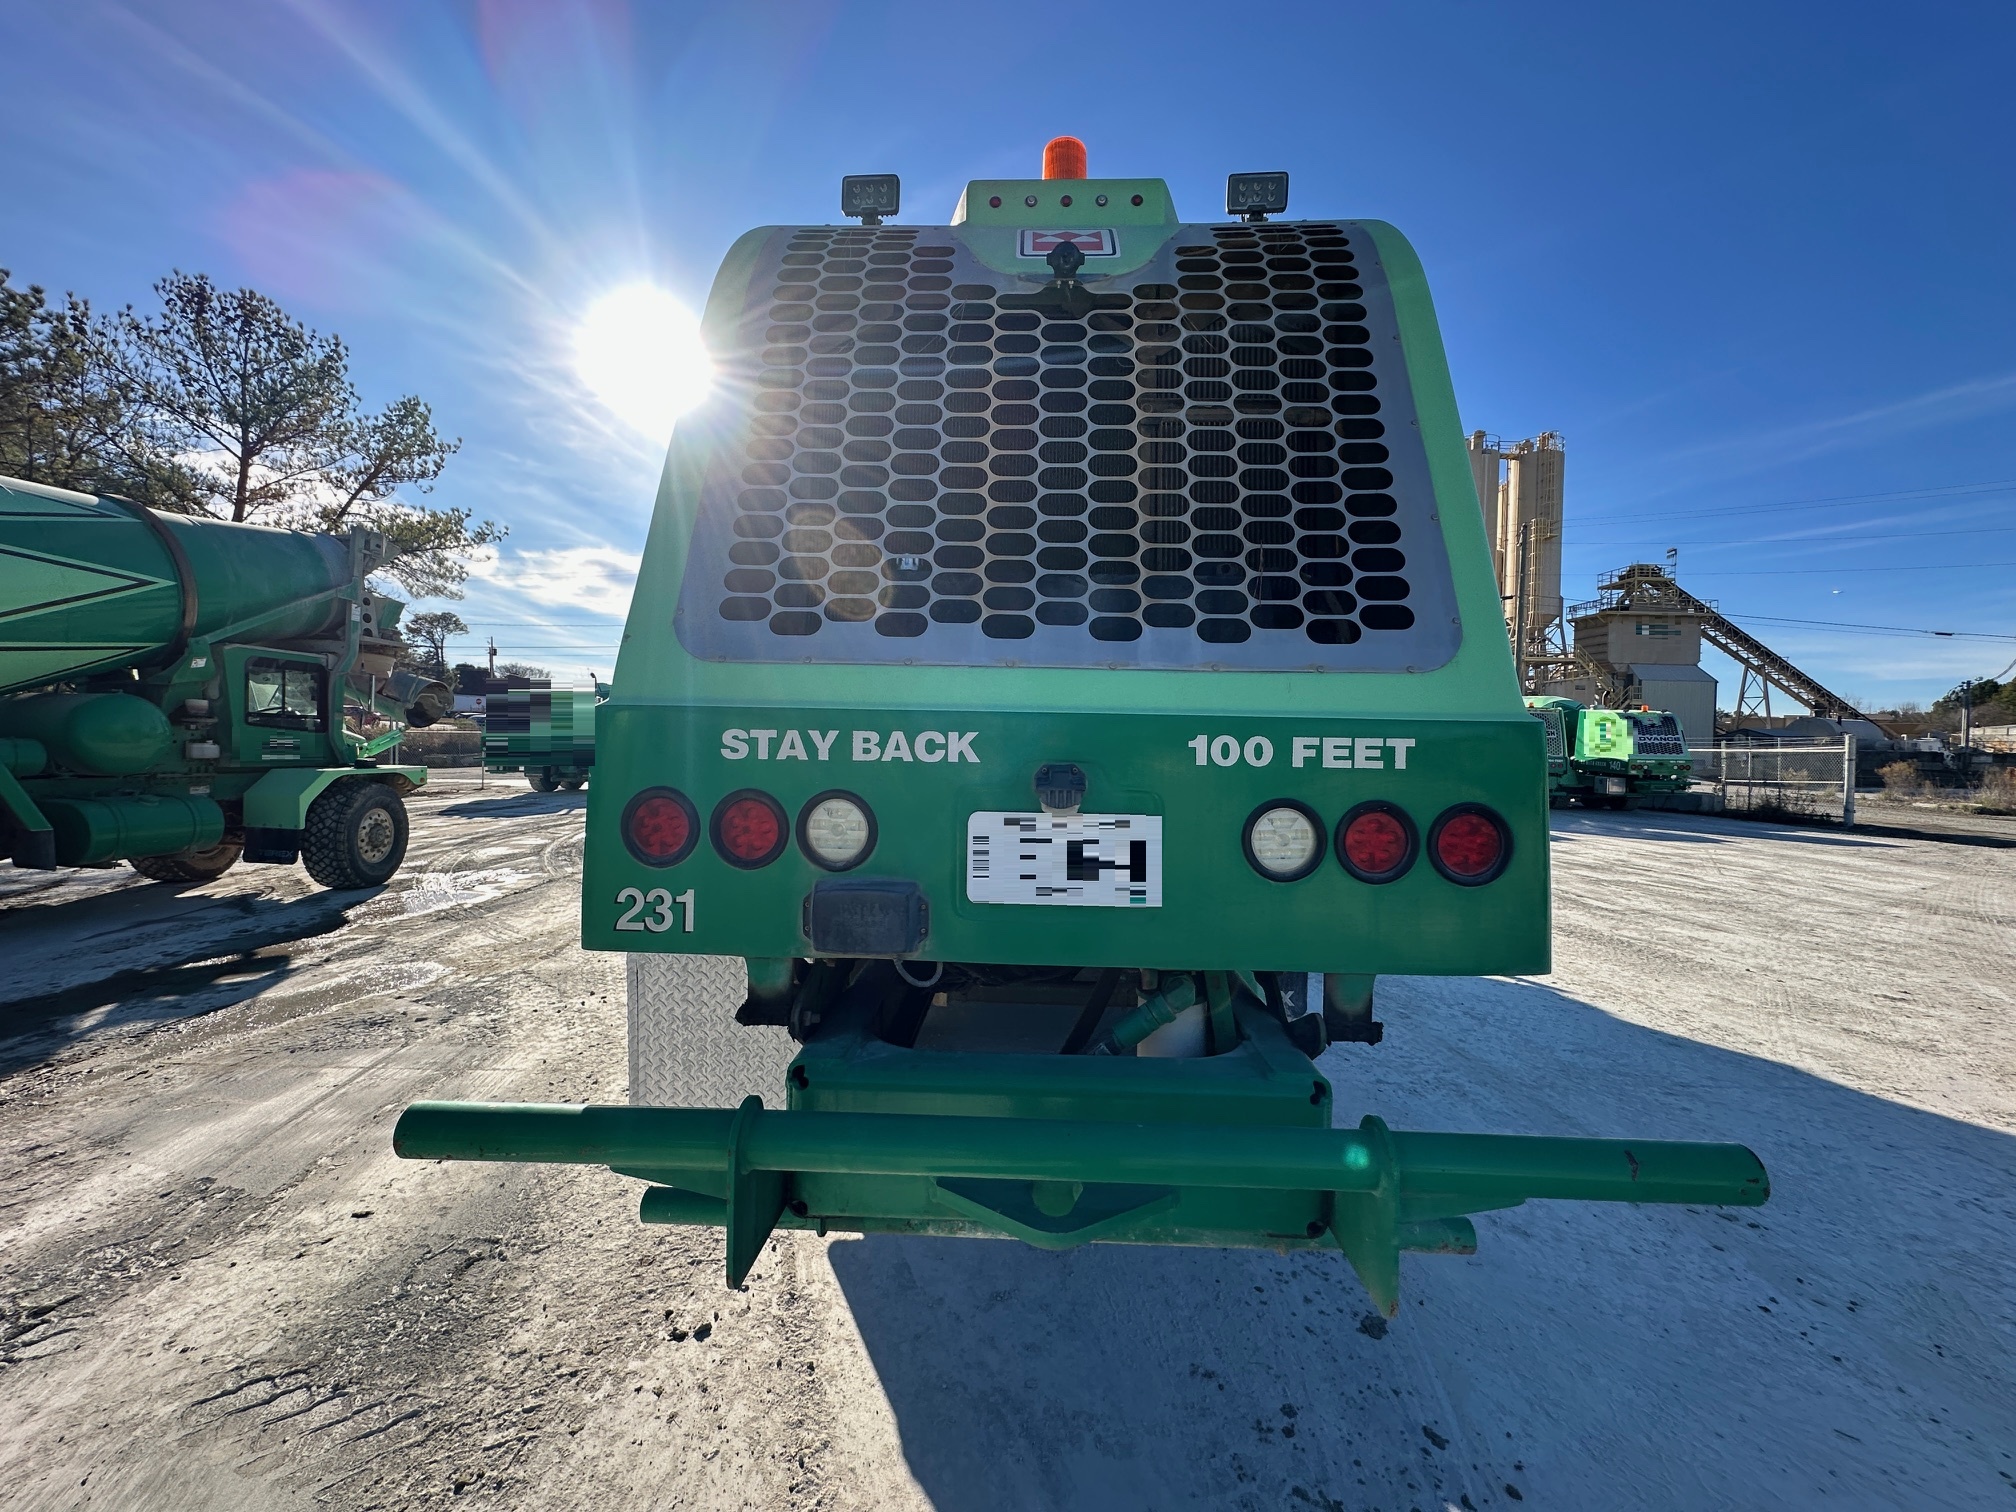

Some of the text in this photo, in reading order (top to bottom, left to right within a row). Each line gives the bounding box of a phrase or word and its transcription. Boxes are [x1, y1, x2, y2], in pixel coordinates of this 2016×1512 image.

[720, 728, 1416, 770] STAY BACK 100 FEET
[614, 886, 695, 933] 231
